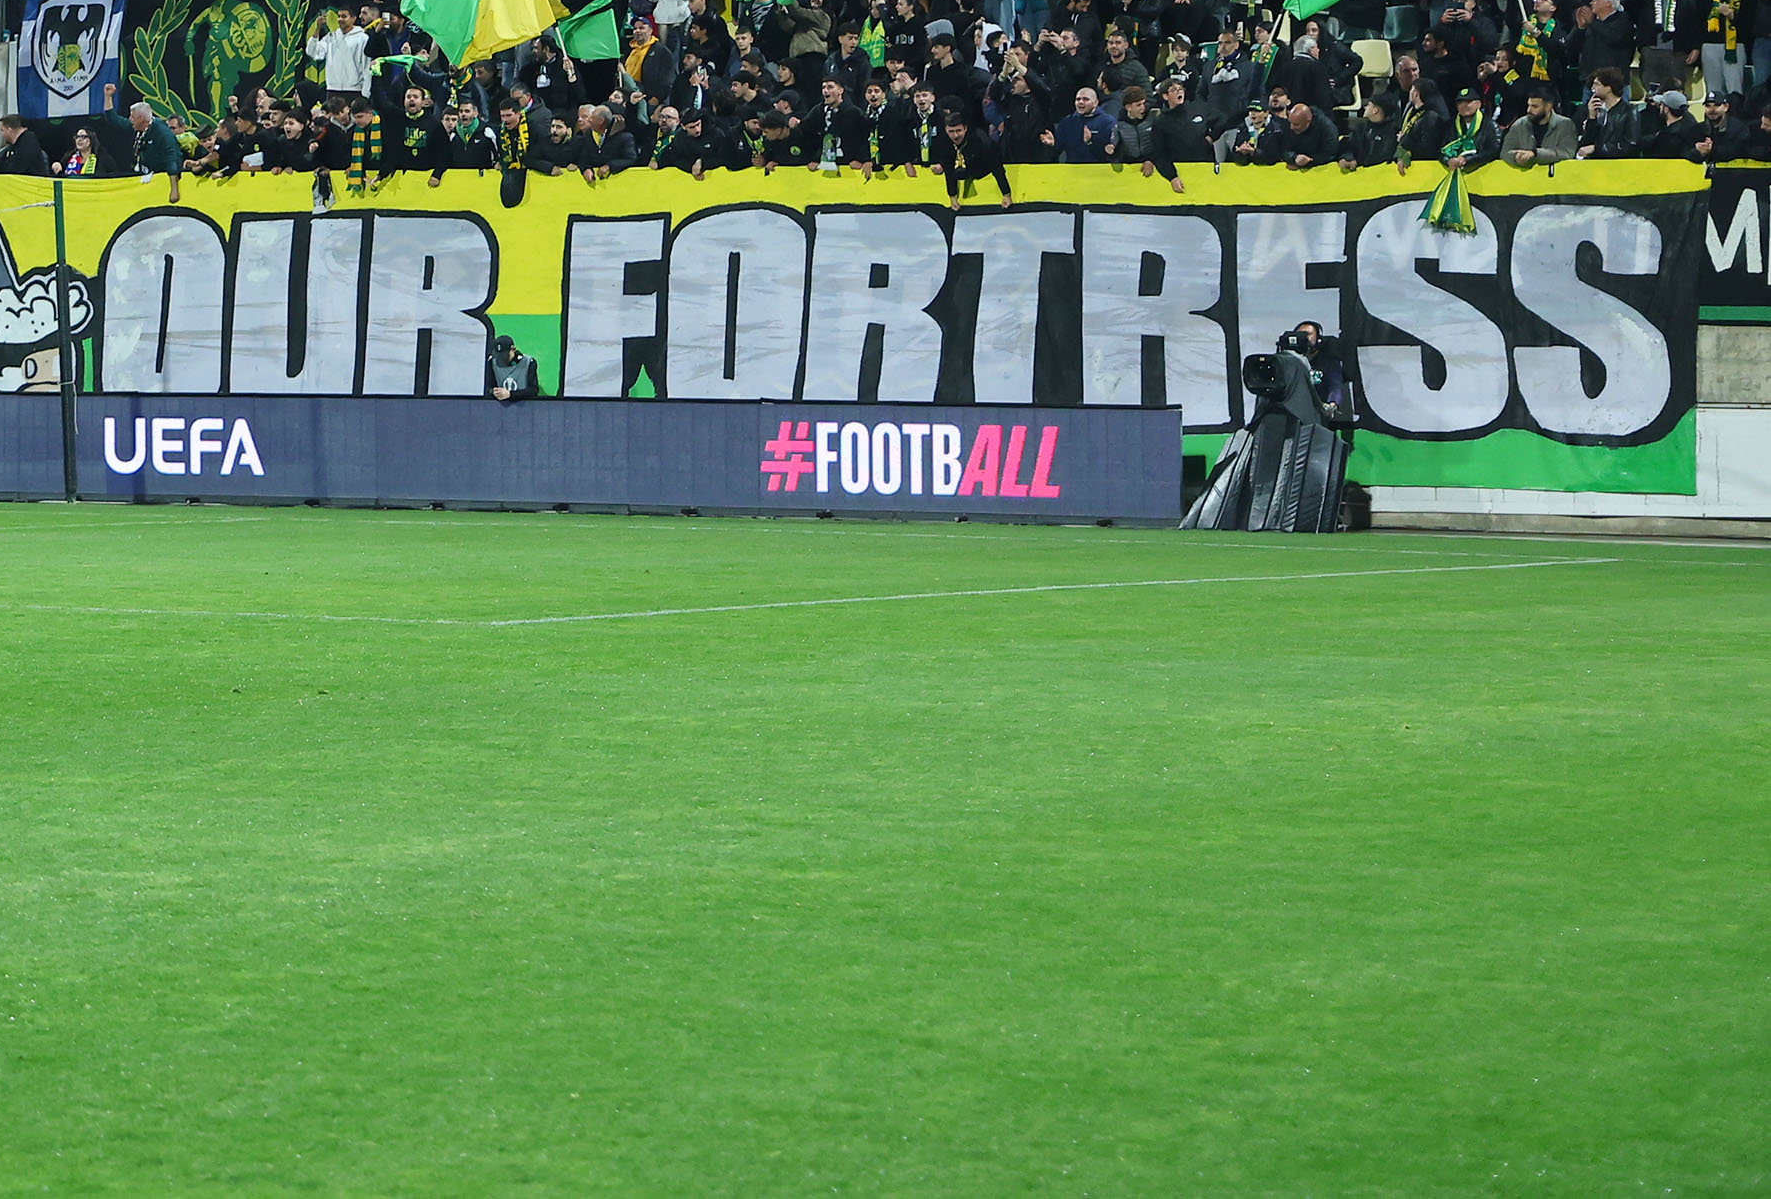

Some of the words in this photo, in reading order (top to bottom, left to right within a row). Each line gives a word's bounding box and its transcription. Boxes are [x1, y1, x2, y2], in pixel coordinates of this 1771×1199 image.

[101, 213, 493, 396] OUR
[563, 201, 1671, 436] FORTRESS
[103, 416, 265, 477] UEFA
[759, 420, 1060, 499] #FOOTBALL
